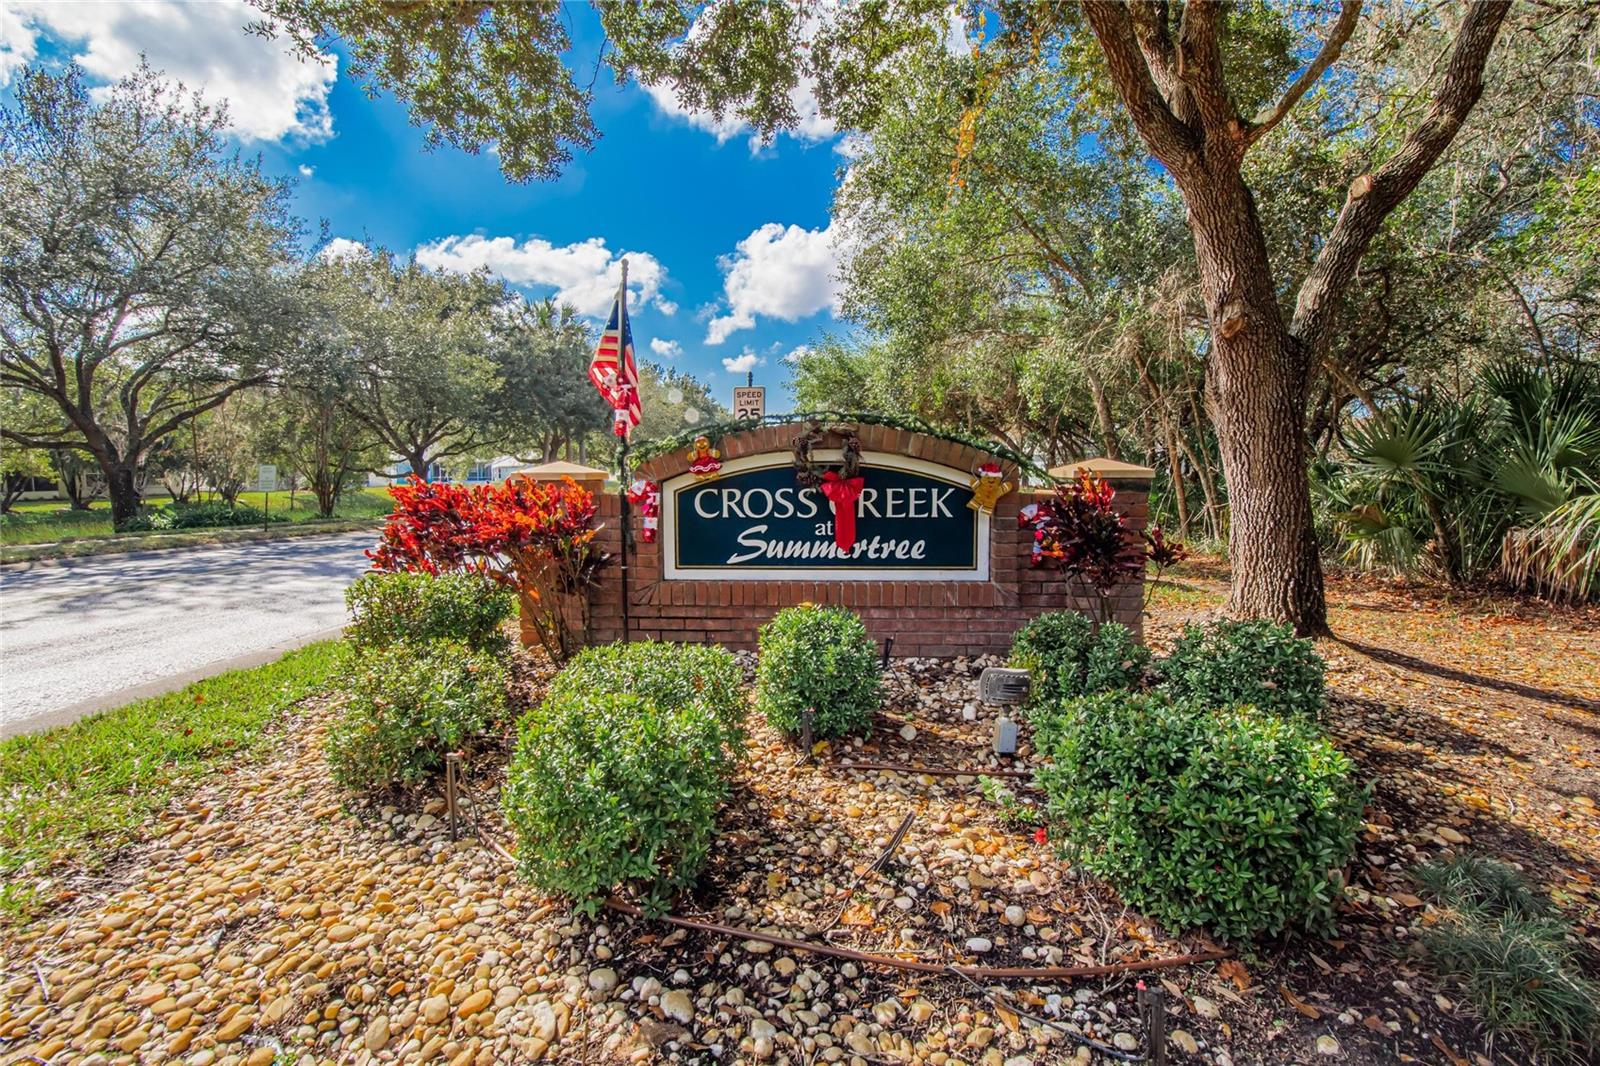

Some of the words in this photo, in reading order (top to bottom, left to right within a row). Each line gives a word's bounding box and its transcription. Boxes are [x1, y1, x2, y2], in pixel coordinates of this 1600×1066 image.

[736, 391, 762, 399] SPEED
[738, 408, 760, 420] 25
[694, 487, 818, 519] CROSS
[829, 487, 956, 519] REEK
[815, 520, 834, 536] at
